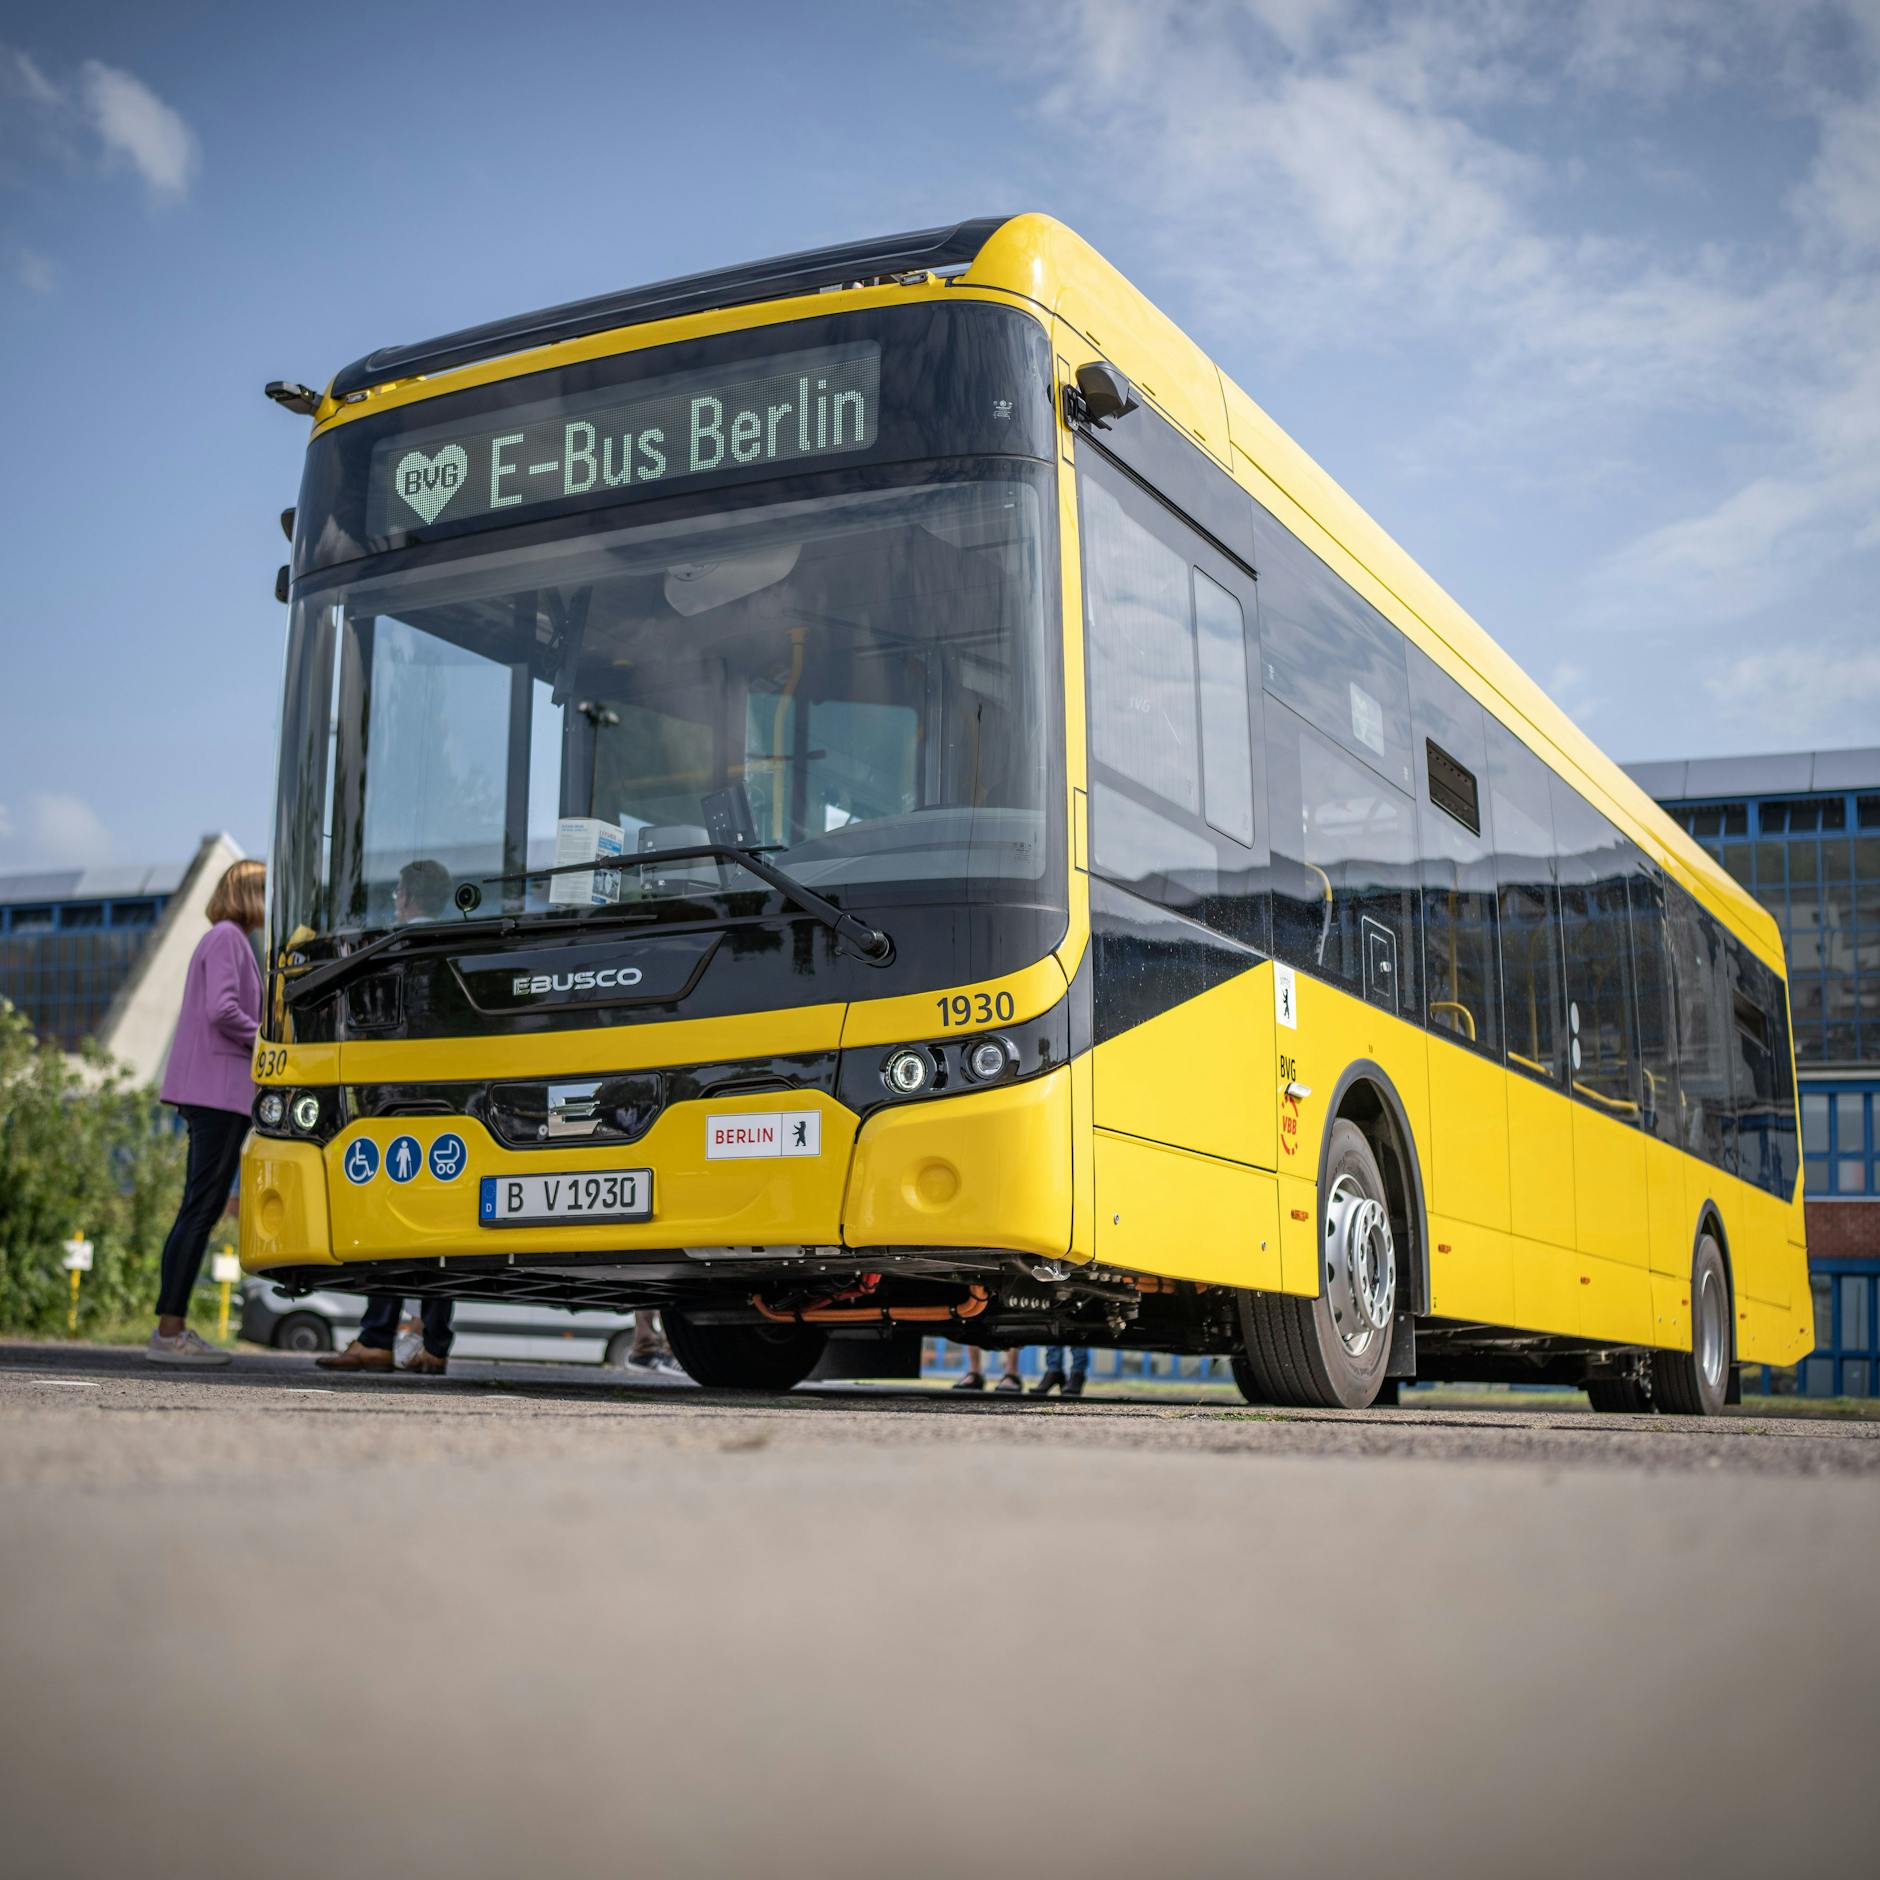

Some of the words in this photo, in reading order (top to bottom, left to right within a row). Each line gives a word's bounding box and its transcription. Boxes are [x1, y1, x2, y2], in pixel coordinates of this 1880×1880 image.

[404, 461, 459, 494] BVG
[490, 421, 666, 510] E-Bus
[689, 377, 865, 473] Berlin
[512, 967, 643, 996] EBUSCO
[936, 991, 1015, 1027] 1930
[256, 1049, 288, 1078] 930
[1280, 1054, 1296, 1082] BVG
[715, 1127, 774, 1145] BERLIN
[1282, 1115, 1297, 1135] VBB
